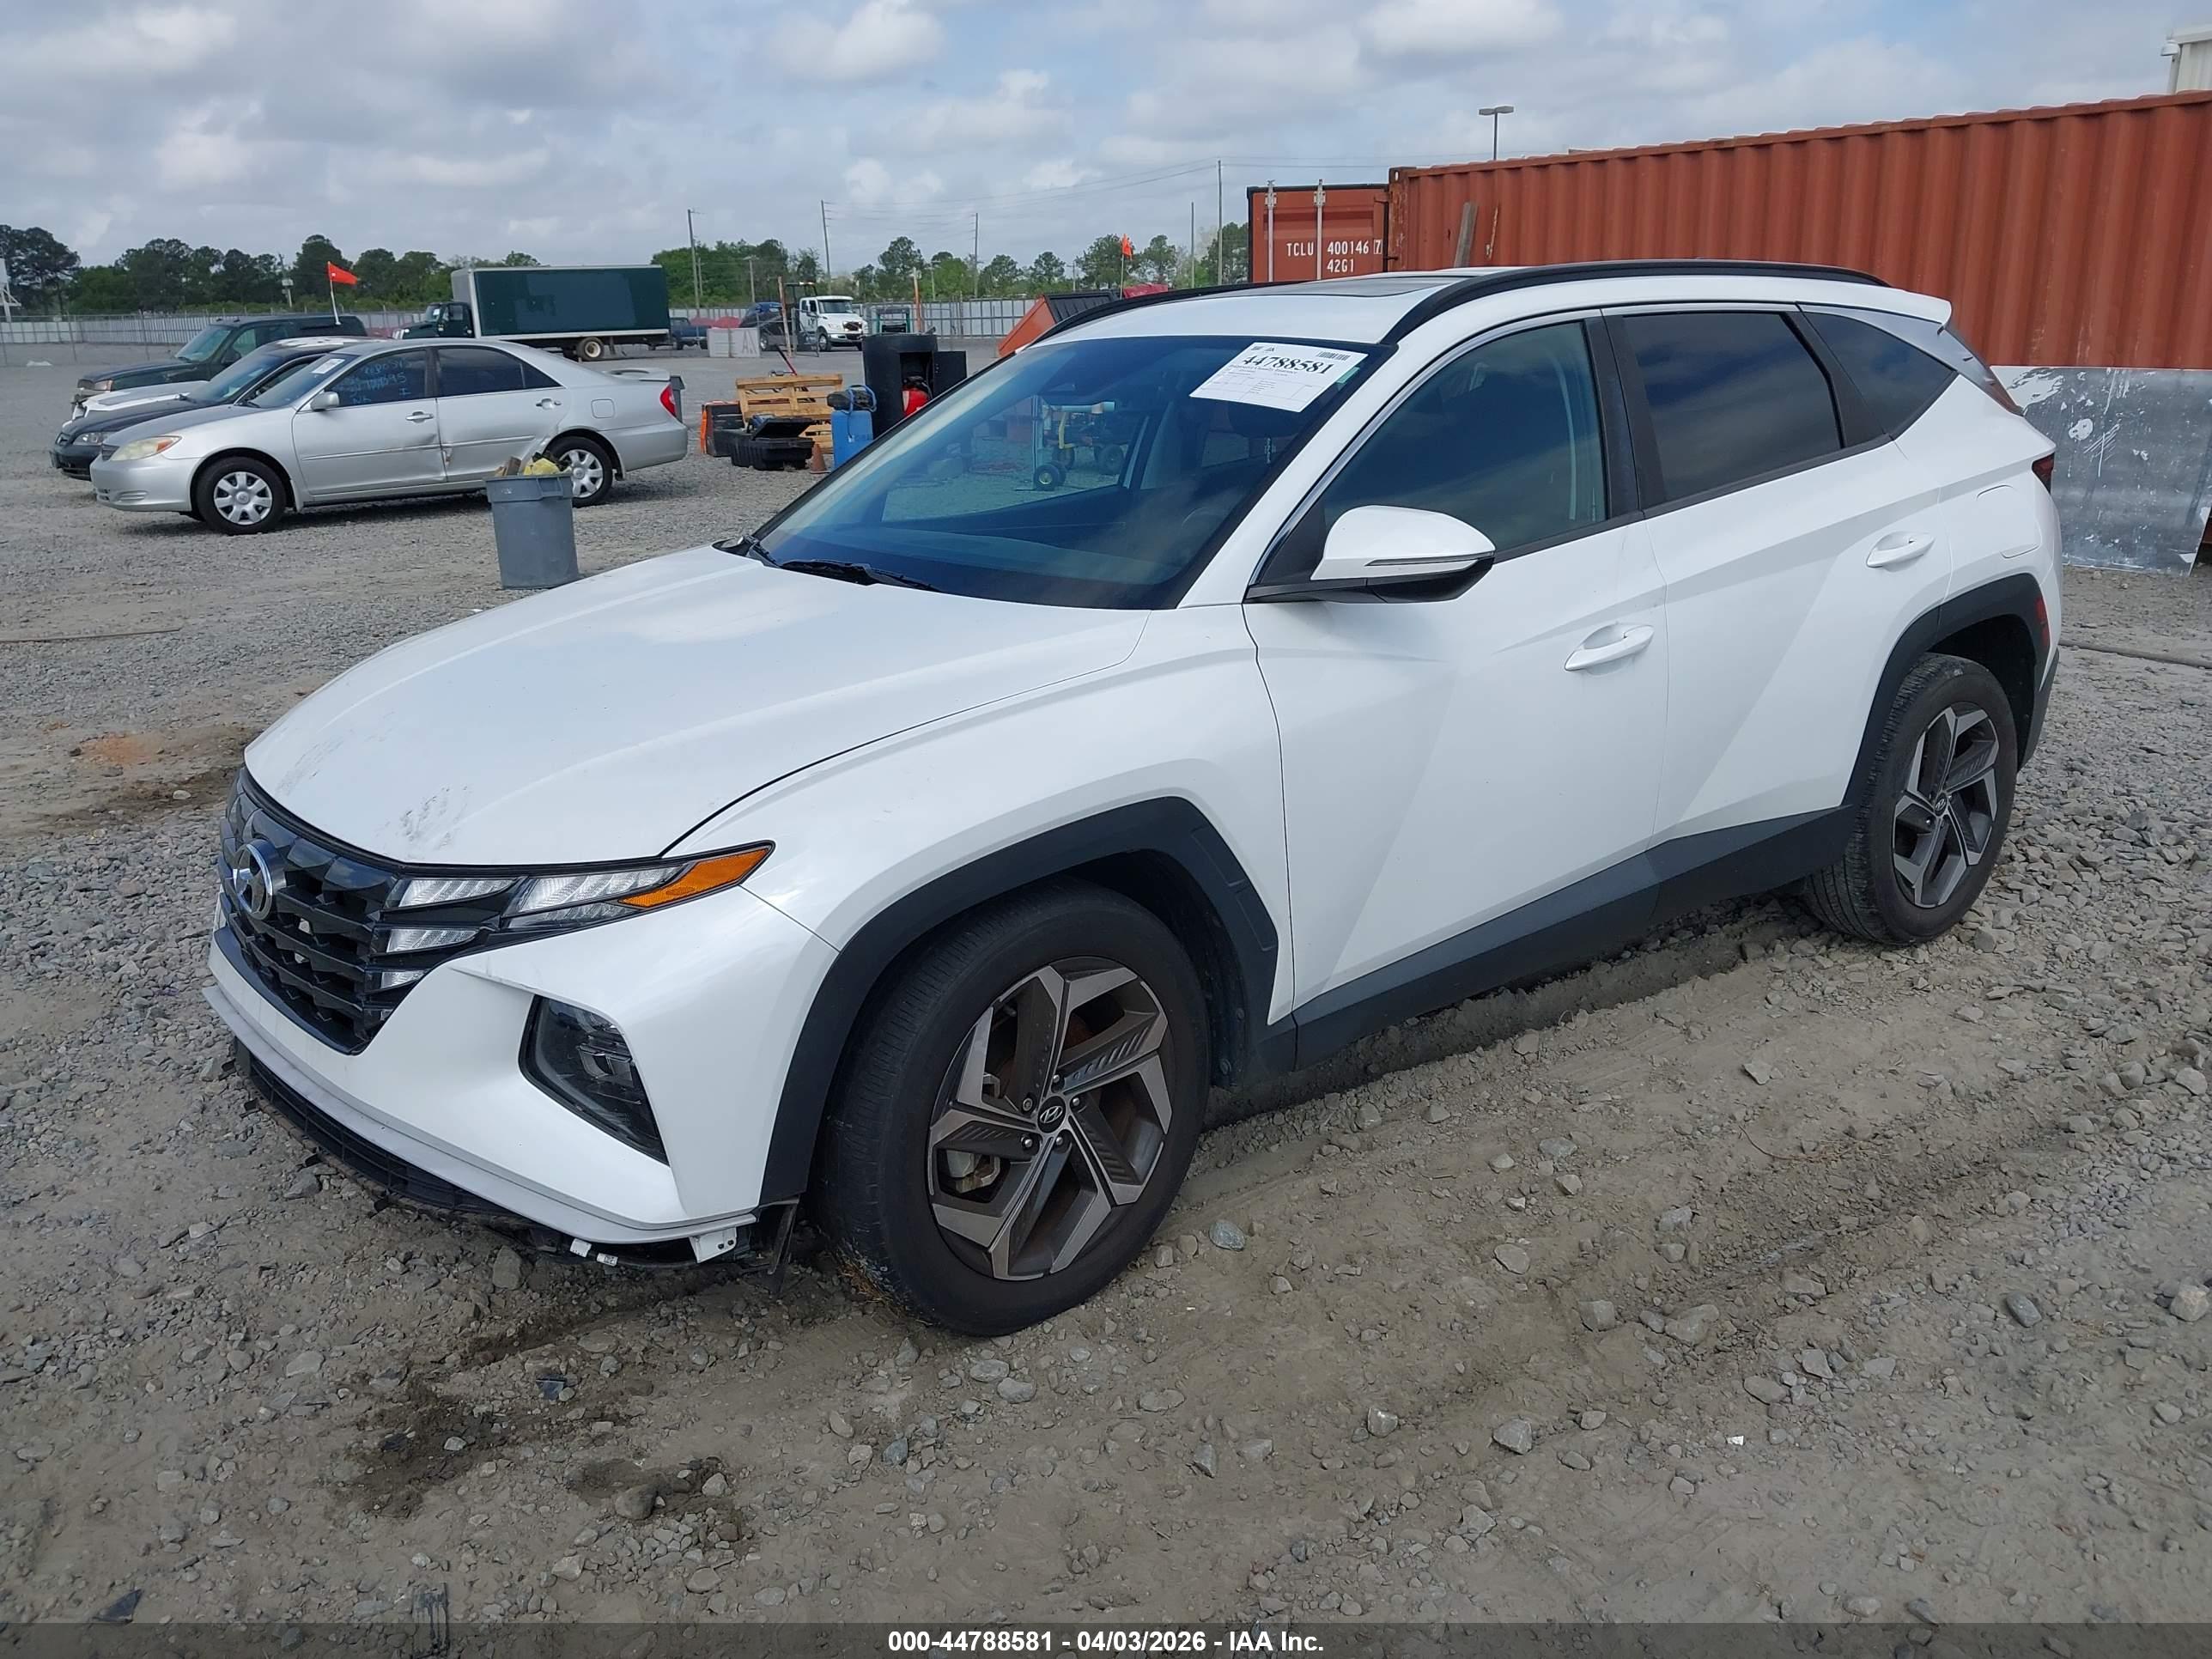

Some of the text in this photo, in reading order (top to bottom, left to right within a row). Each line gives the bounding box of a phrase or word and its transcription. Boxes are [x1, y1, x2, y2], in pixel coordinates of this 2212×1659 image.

[1286, 240, 1382, 257] TCLU 400146 7
[1327, 258, 1354, 273] 42G1
[1242, 354, 1335, 374] 44788581
